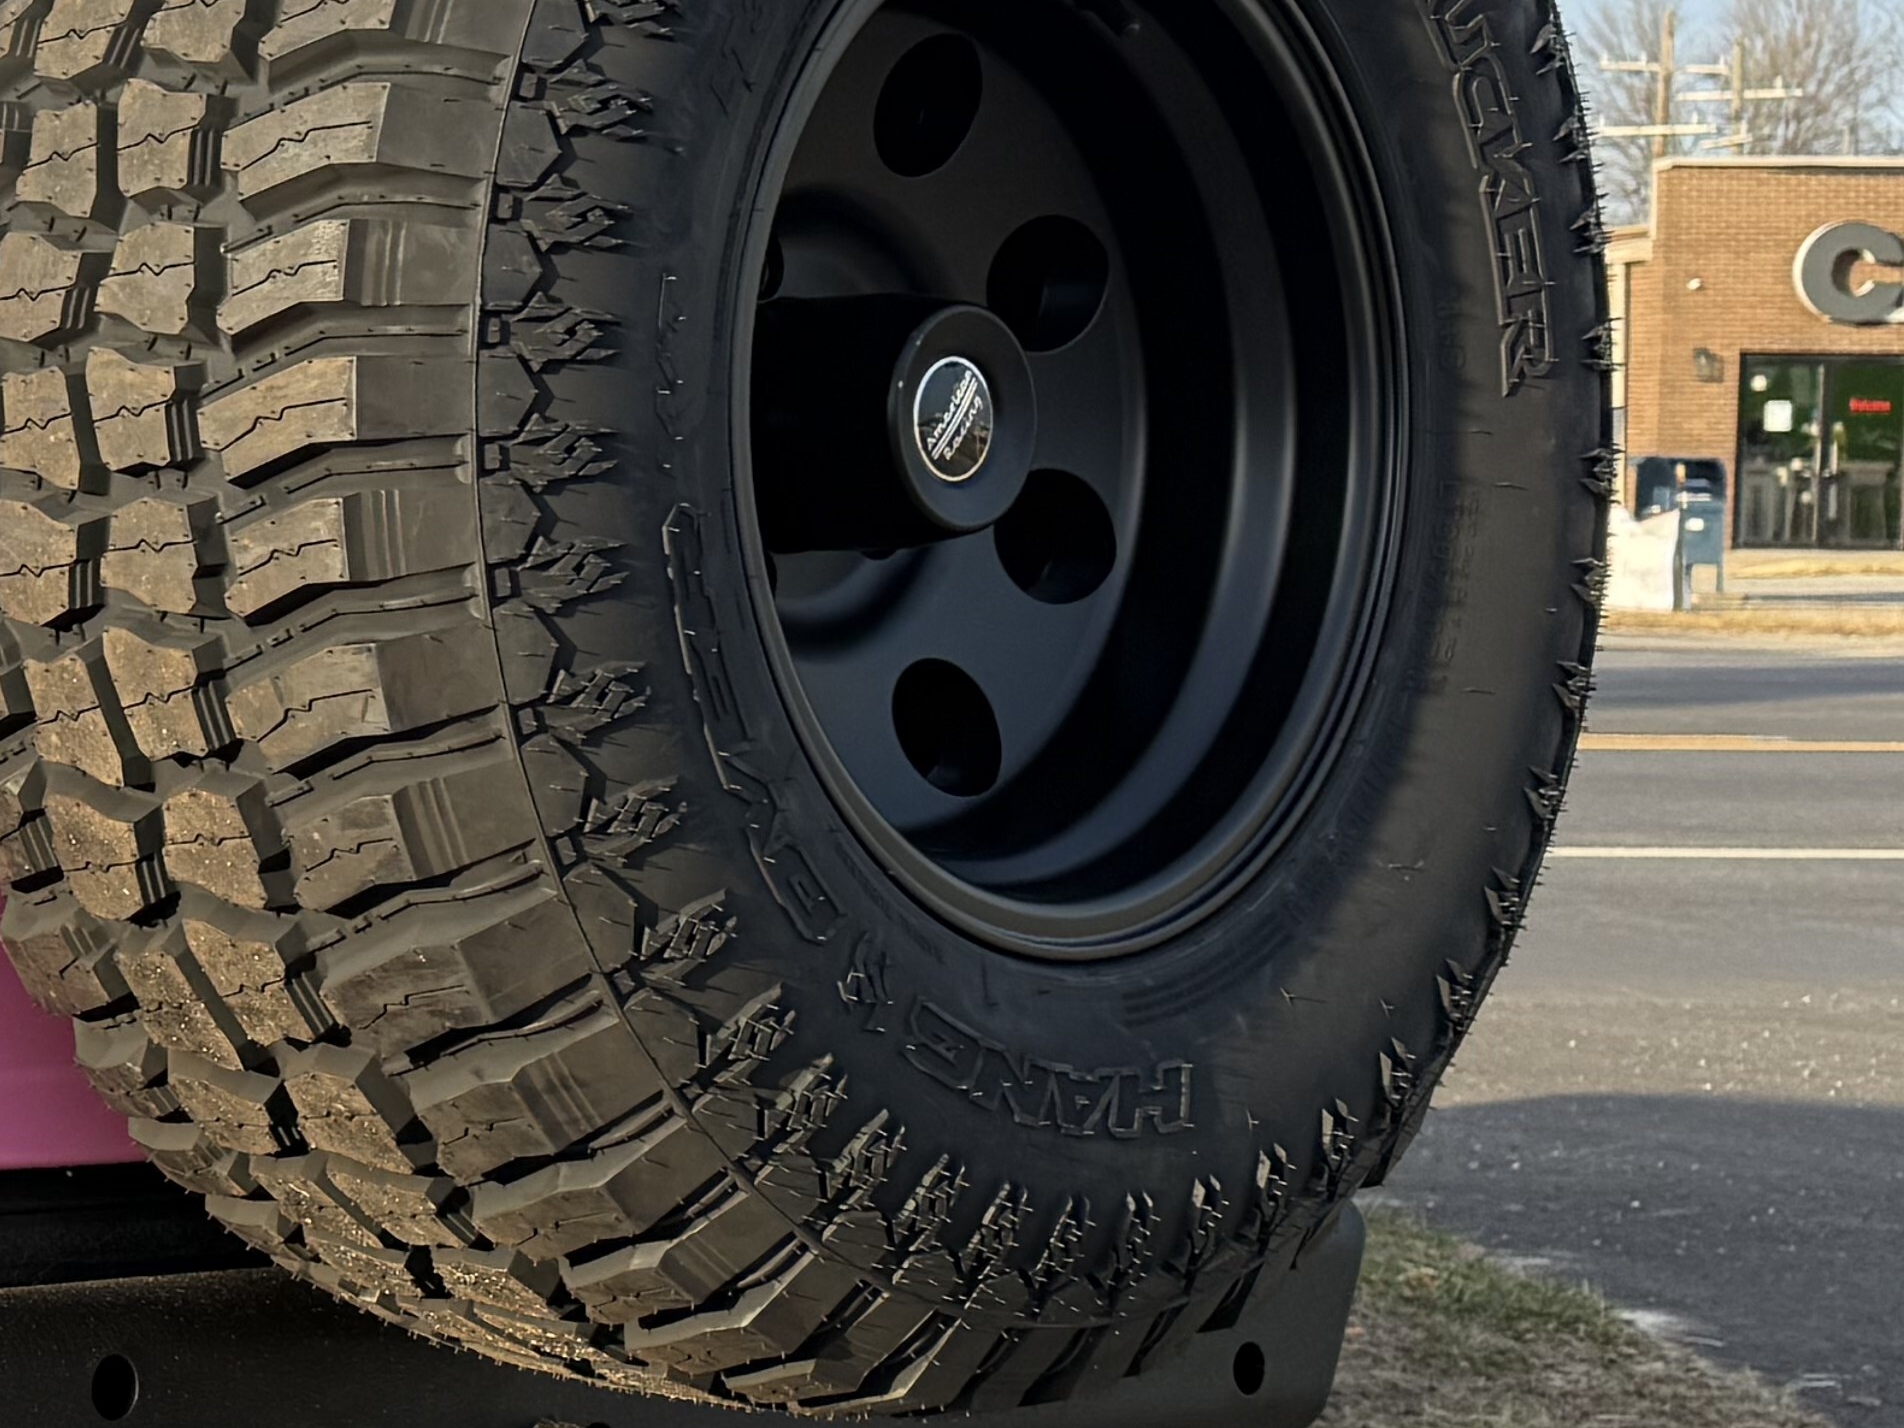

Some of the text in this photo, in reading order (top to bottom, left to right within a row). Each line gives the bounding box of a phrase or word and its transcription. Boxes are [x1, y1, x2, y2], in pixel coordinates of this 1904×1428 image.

[926, 369, 973, 451] American
[942, 395, 984, 461] Racing
[903, 998, 1195, 1139] HANG
